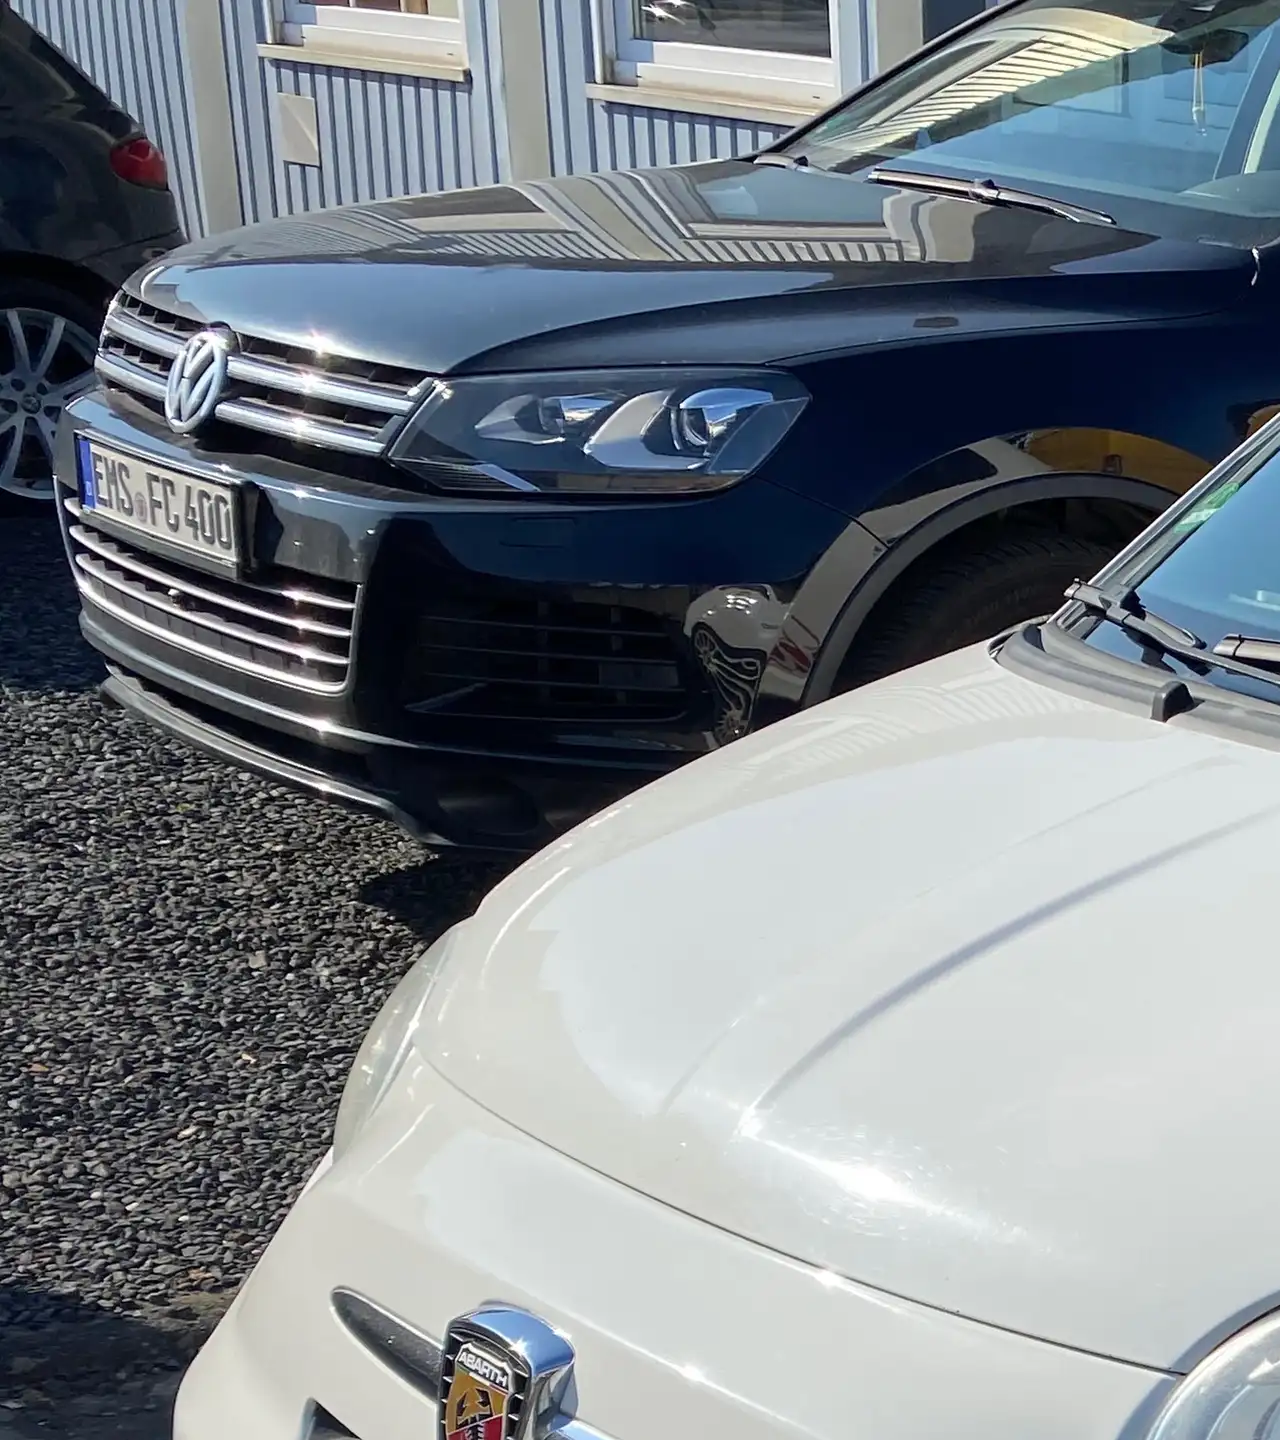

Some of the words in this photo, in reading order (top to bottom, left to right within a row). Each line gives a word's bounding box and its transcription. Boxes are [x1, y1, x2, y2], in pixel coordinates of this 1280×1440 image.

[92, 451, 134, 517] EMS
[146, 472, 180, 533] FC
[184, 484, 233, 550] 400
[459, 1351, 508, 1388] ABARTH
